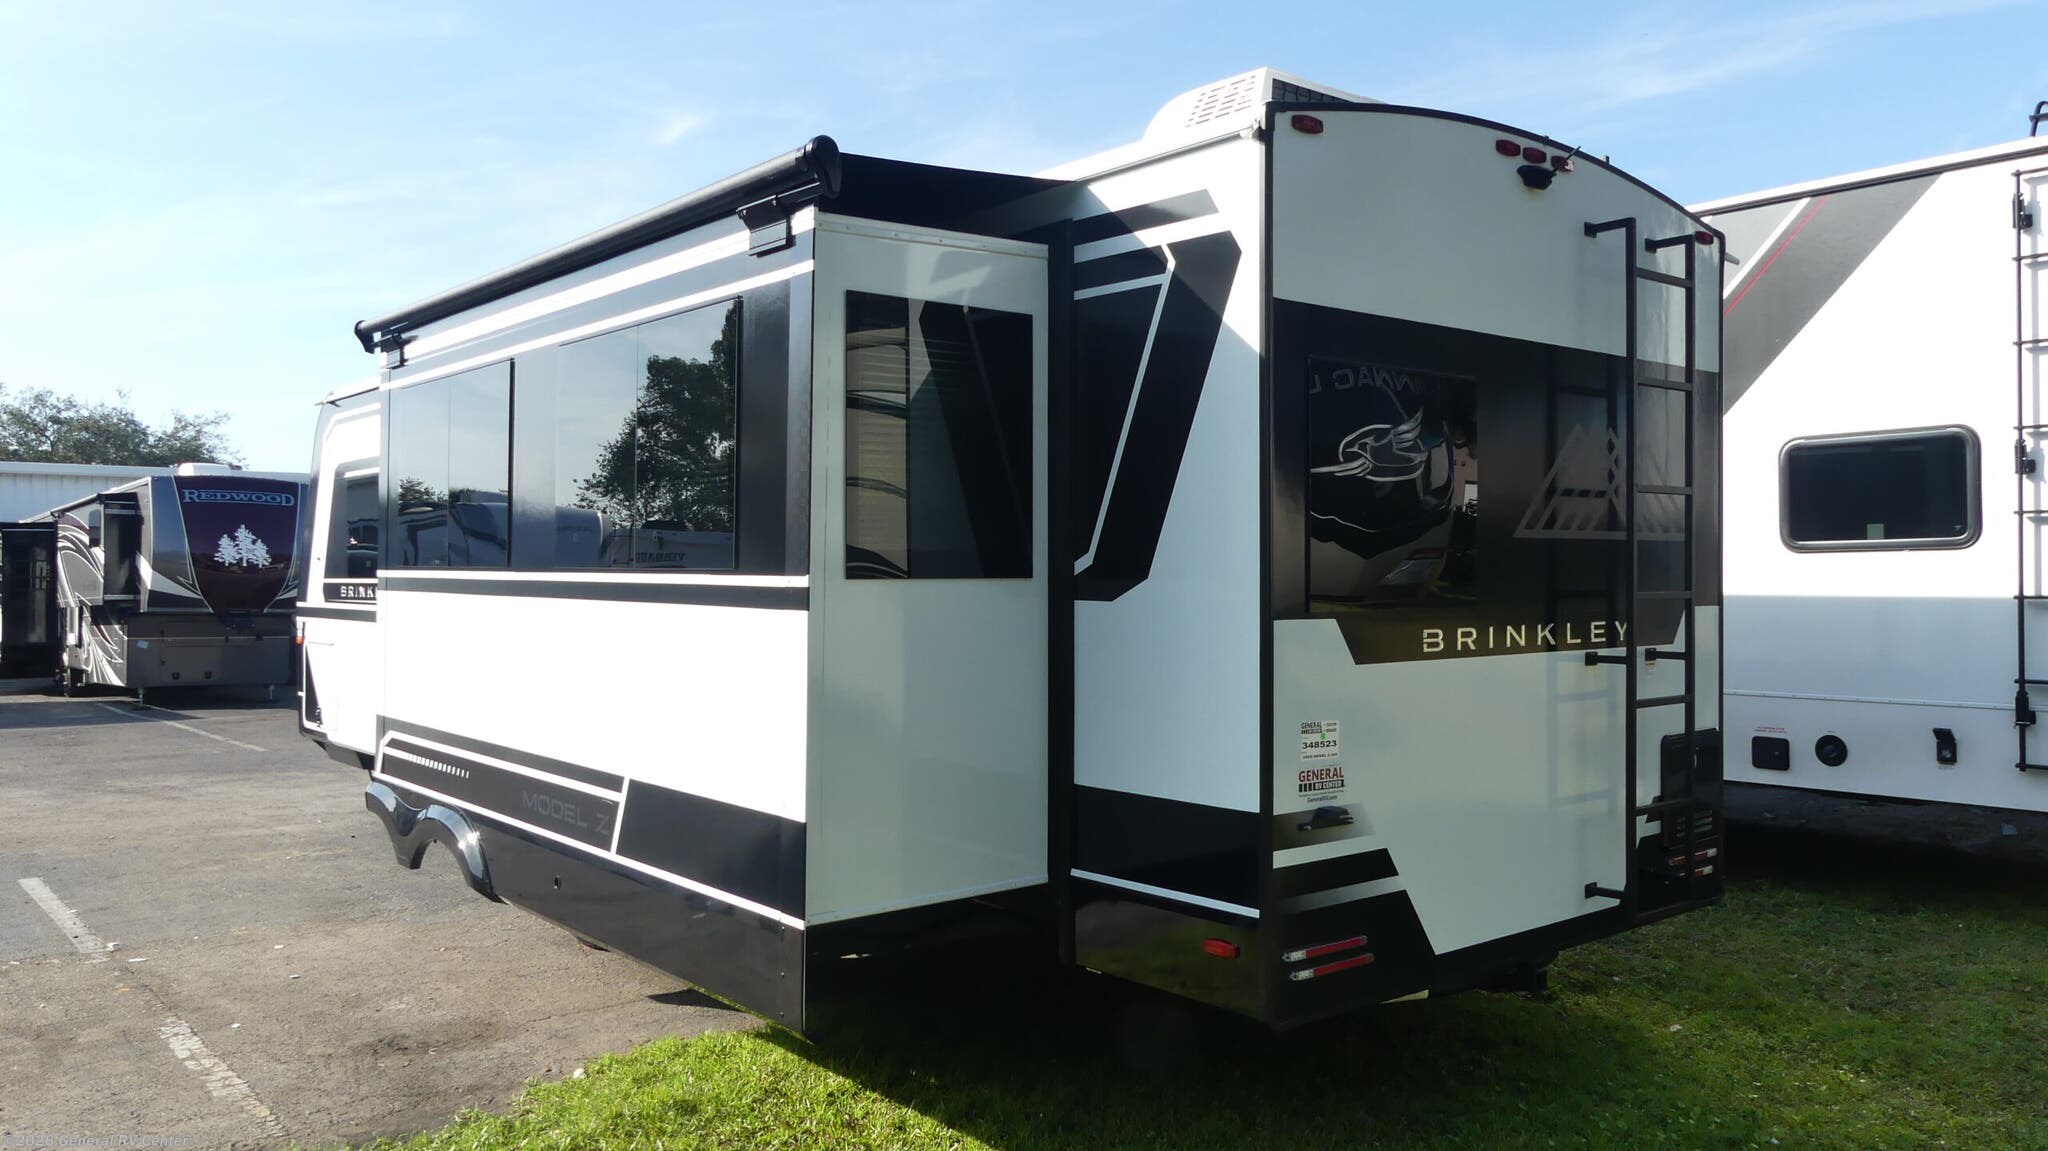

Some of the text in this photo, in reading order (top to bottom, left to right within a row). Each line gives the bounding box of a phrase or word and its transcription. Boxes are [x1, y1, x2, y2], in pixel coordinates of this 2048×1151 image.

[183, 489, 295, 506] REDWOOD
[1422, 620, 1627, 653] BRINKLEY
[1302, 740, 1337, 749] 348523
[1298, 766, 1344, 782] GENERAL
[1322, 781, 1342, 789] CENTER
[521, 789, 611, 836] MODEL Z
